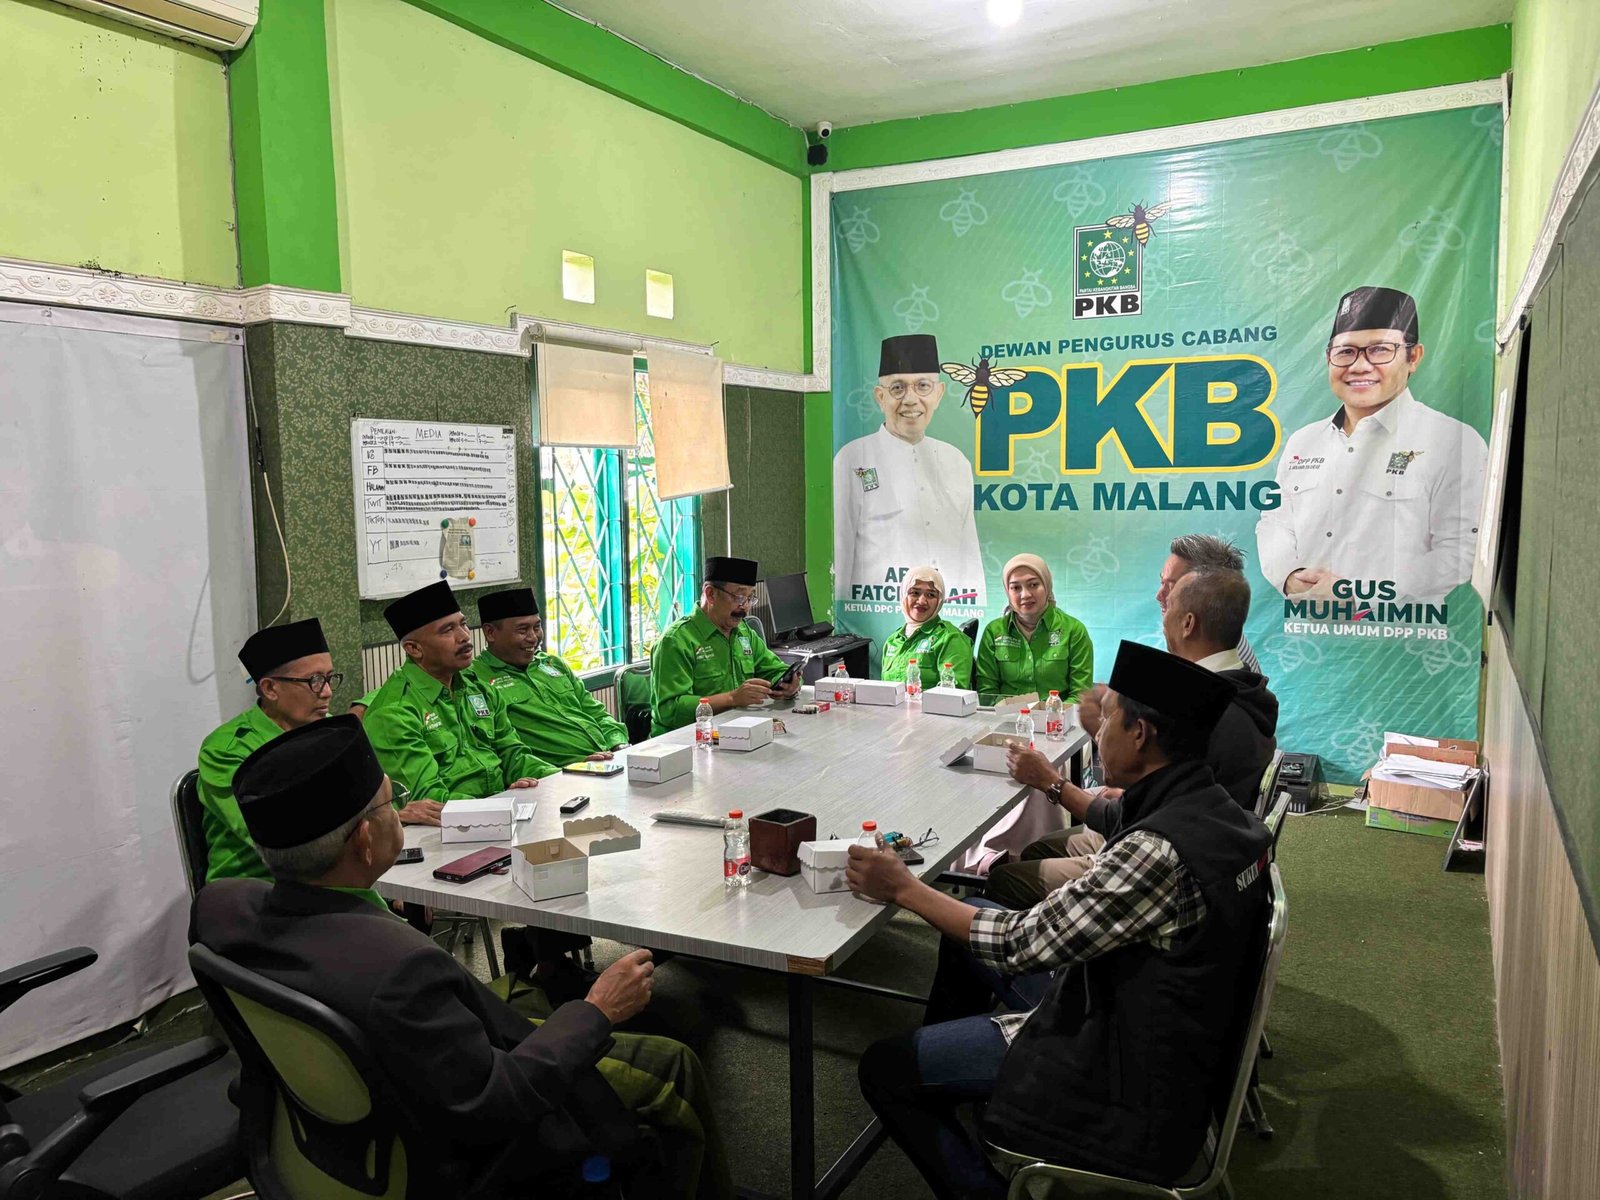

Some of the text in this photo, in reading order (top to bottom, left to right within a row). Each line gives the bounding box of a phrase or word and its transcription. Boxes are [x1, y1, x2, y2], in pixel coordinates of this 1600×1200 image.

[1075, 294, 1140, 317] PKB
[981, 325, 1278, 359] DEWAN PENGURUS CABANG
[975, 354, 1282, 477] PKB
[415, 427, 442, 440] MEDIA
[367, 465, 379, 476] FB
[1386, 468, 1405, 476] PKB
[973, 480, 1282, 512] KOTA MALANG
[369, 538, 382, 555] YT
[1332, 579, 1397, 601] GUS
[844, 603, 872, 612] KETUA
[874, 604, 893, 613] DPC
[943, 607, 984, 618] MALANG
[1284, 599, 1448, 625] MUHAIMIN
[1284, 623, 1448, 640] KETUA UMUM DPP PKB
